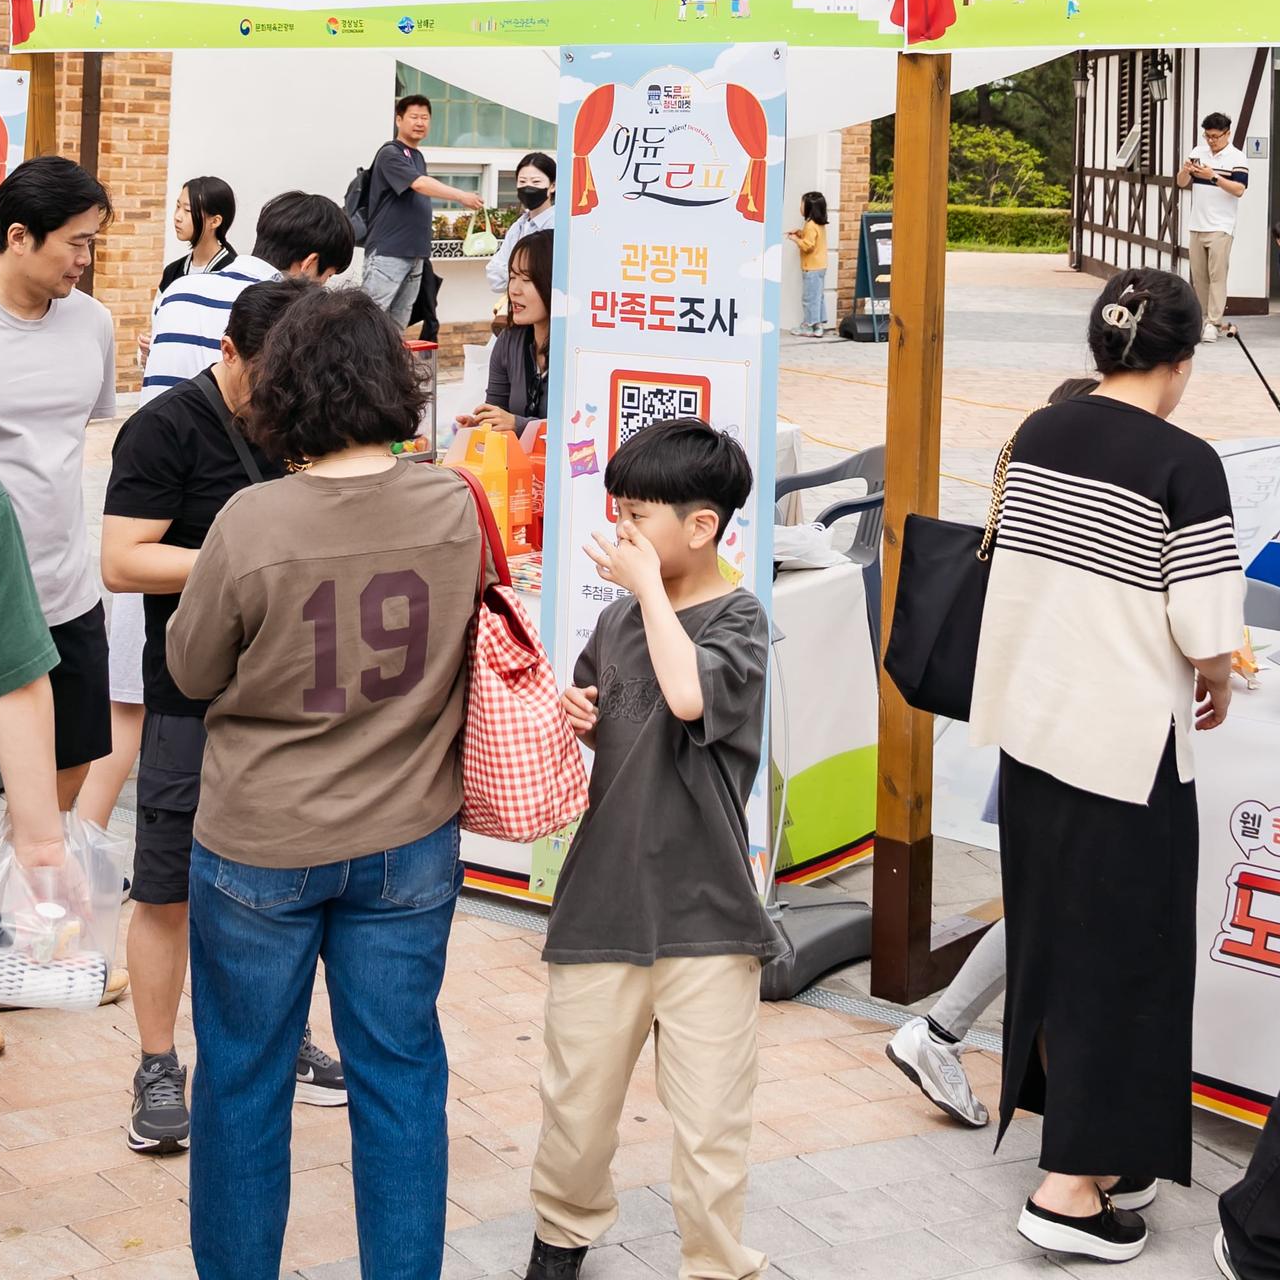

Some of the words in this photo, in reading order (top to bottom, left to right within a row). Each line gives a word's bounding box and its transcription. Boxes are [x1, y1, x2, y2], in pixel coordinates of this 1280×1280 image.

[417, 19, 435, 29] 남해군
[620, 244, 709, 285] 관광객
[590, 290, 738, 337] 만족도조사
[581, 584, 614, 602] 추첨을
[303, 569, 429, 713] 19
